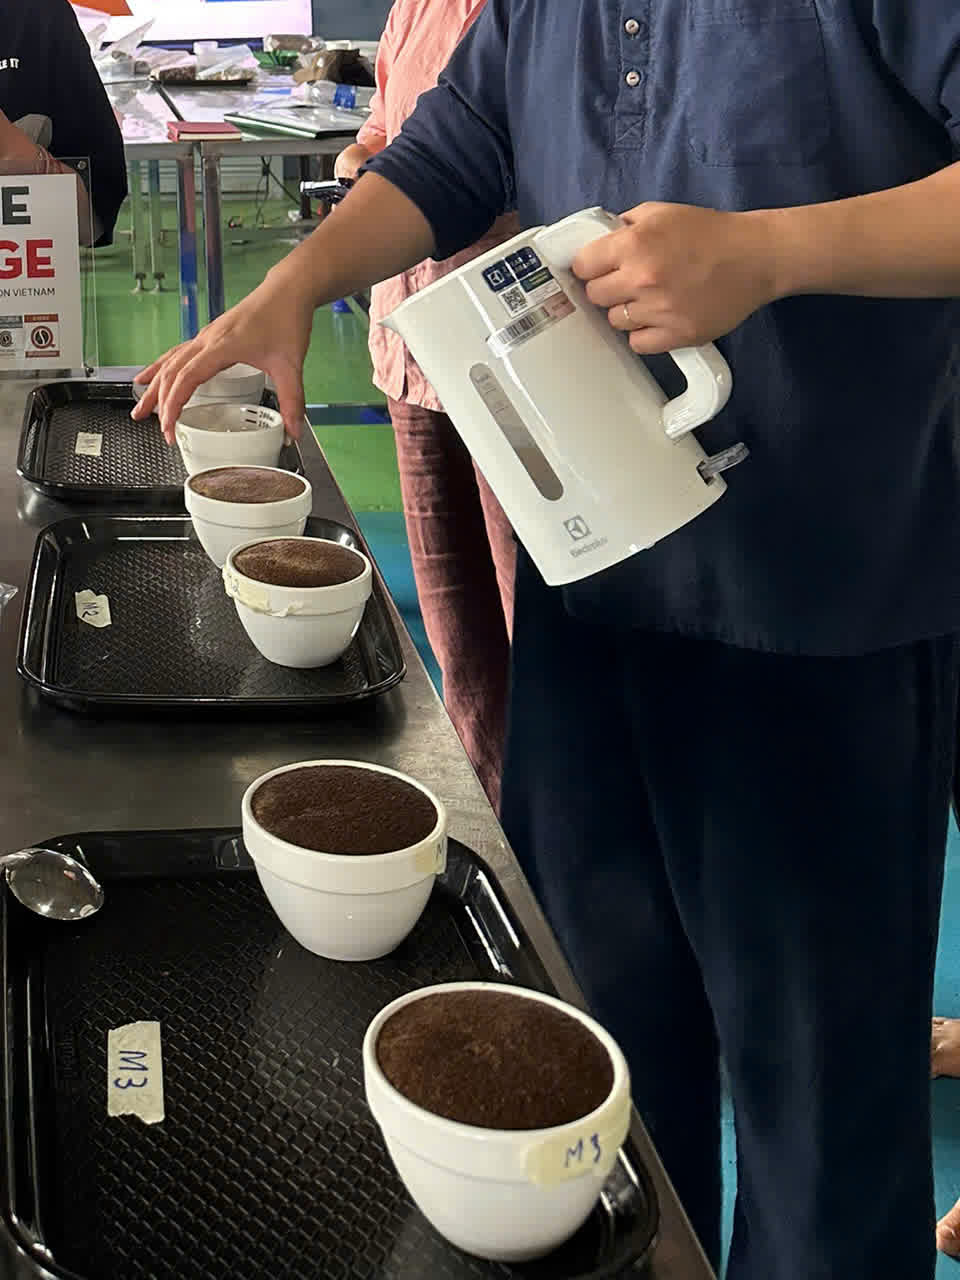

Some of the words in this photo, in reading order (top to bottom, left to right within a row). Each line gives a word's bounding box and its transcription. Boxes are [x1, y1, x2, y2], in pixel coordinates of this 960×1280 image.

[9, 58, 20, 69] IT
[12, 287, 56, 297] VIETNAM
[113, 1050, 149, 1089] M3
[564, 1132, 602, 1168] M3
